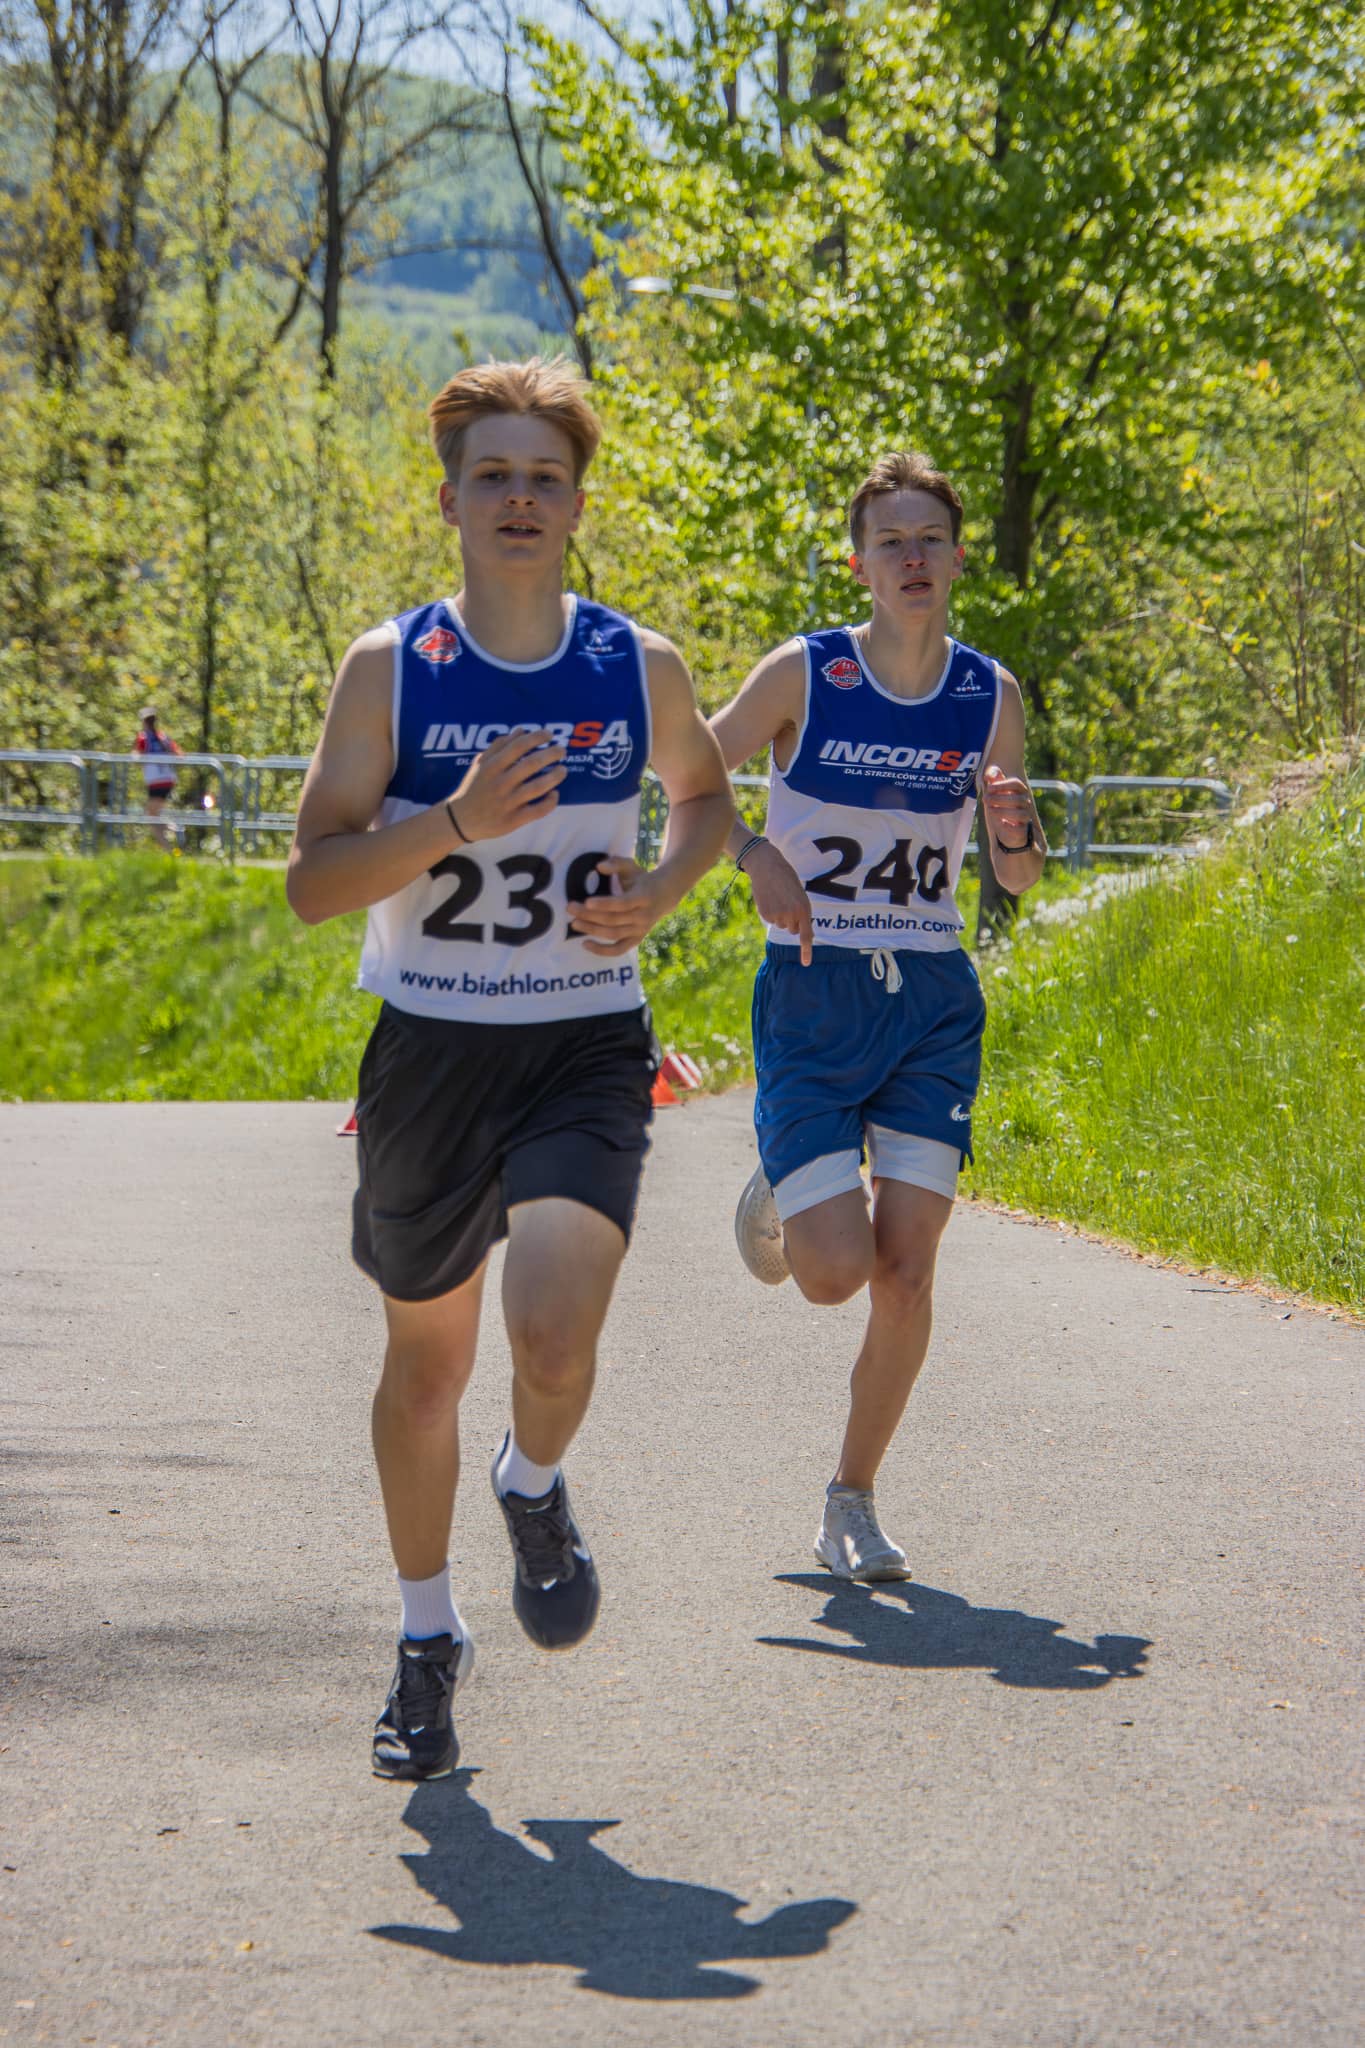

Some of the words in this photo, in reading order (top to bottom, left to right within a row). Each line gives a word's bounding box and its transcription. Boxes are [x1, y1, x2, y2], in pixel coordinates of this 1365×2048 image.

[422, 720, 628, 750] INCRSA
[818, 740, 982, 772] INCORSA
[864, 769, 918, 781] STRZELCÓW
[805, 835, 950, 907] 240
[810, 913, 965, 934] w.biathlon.com
